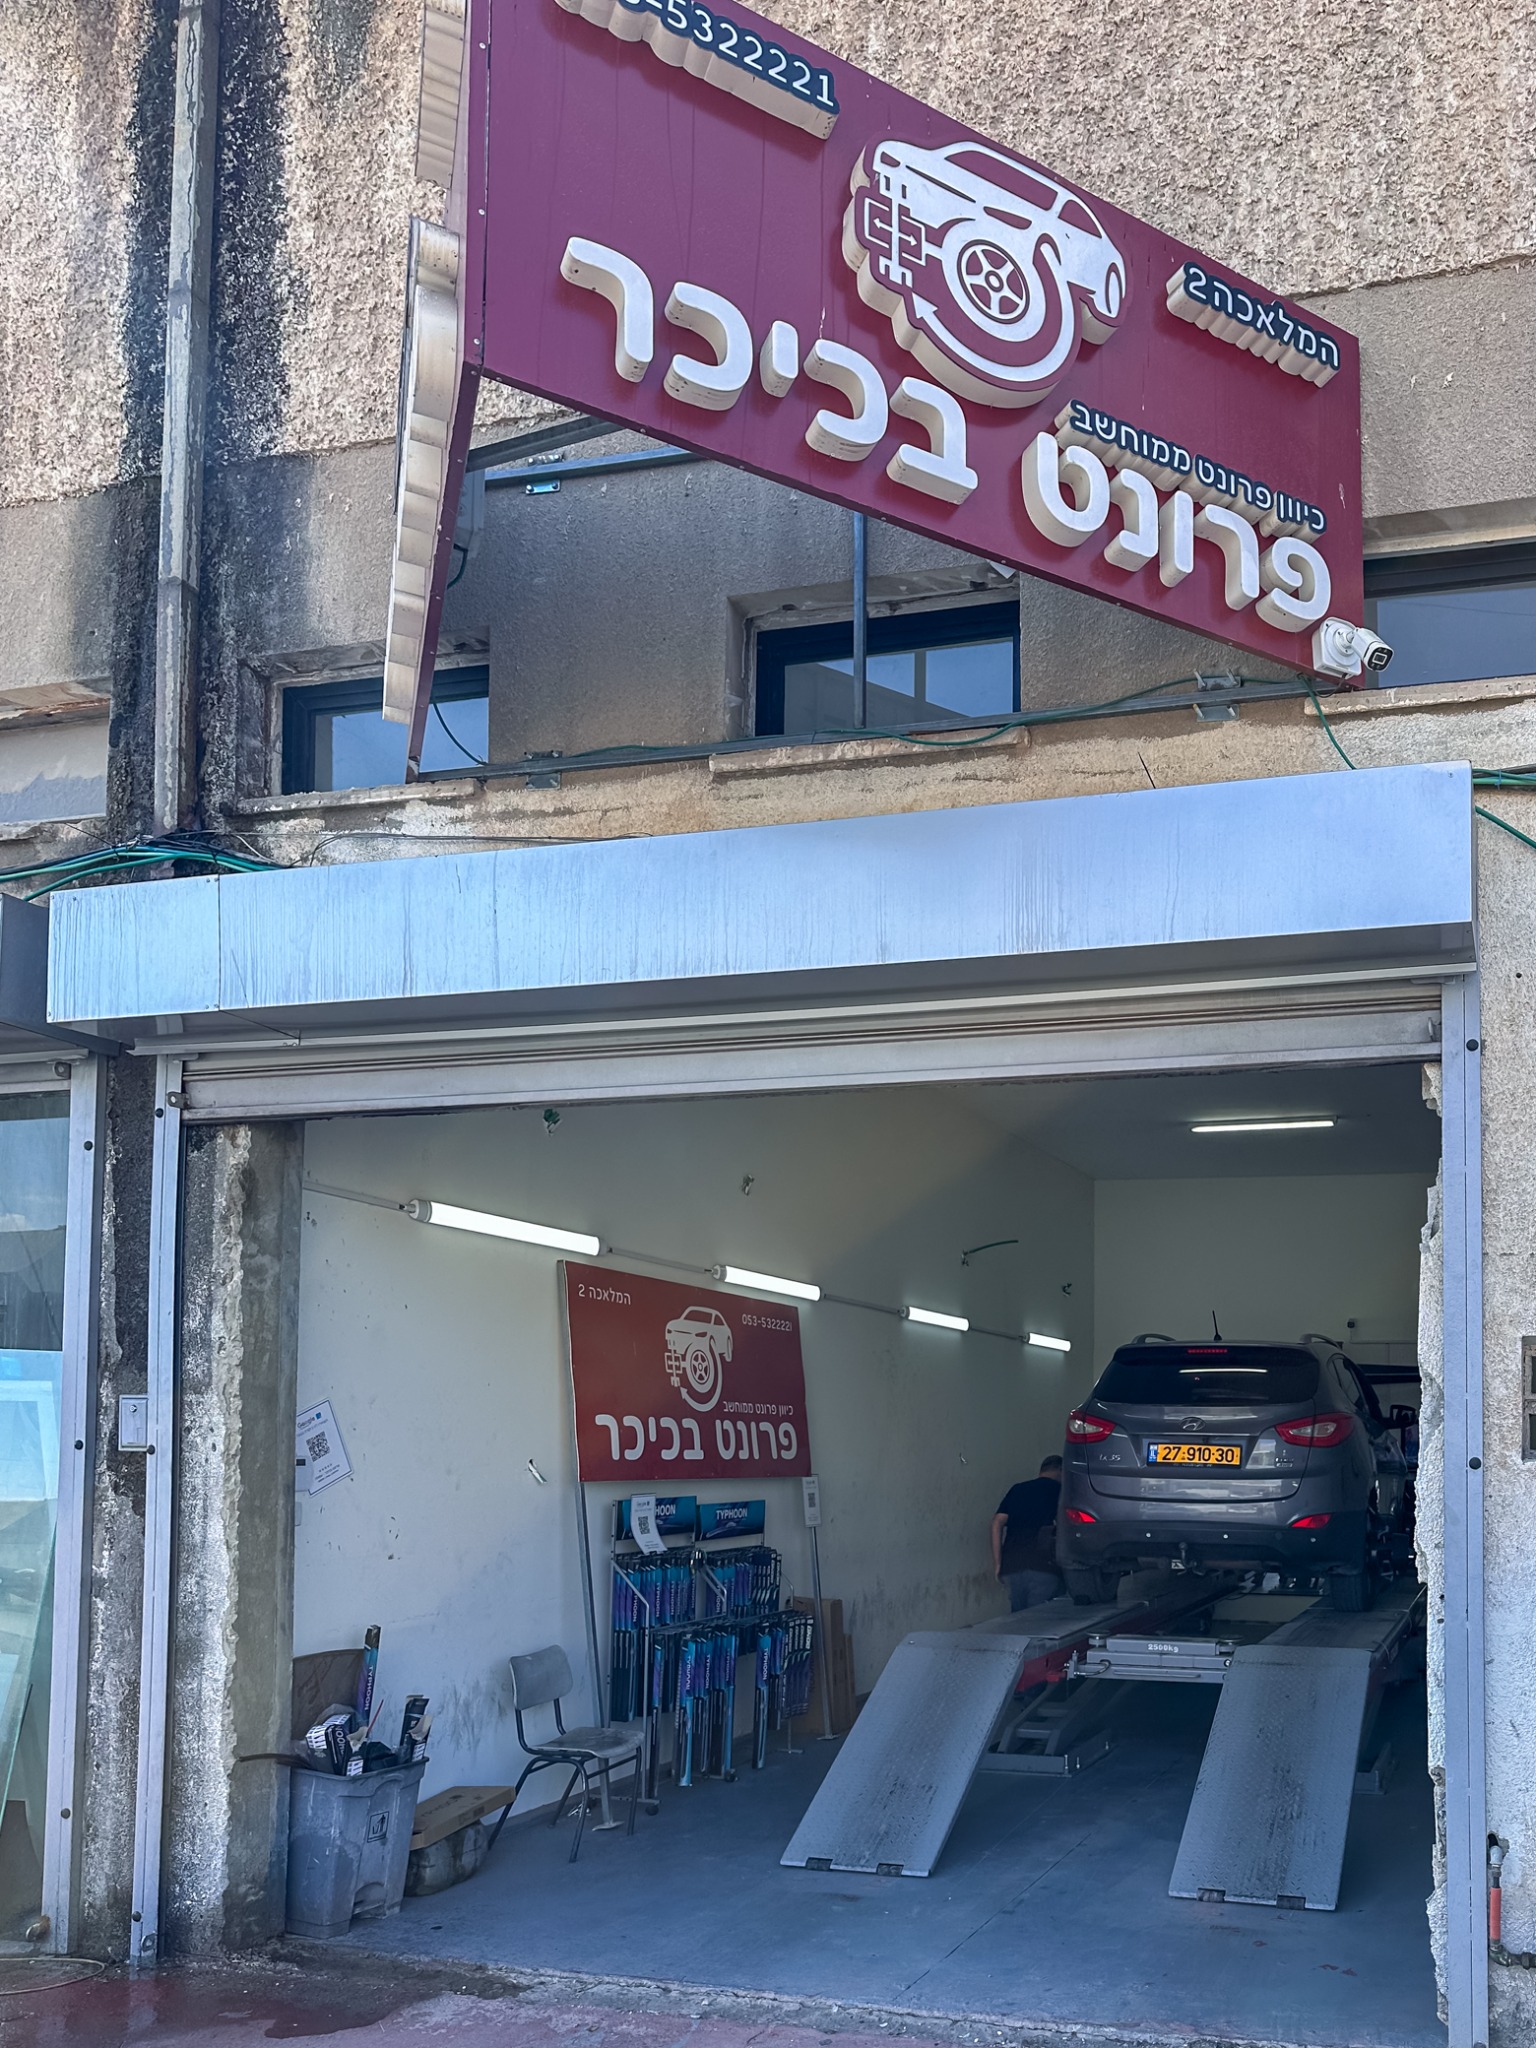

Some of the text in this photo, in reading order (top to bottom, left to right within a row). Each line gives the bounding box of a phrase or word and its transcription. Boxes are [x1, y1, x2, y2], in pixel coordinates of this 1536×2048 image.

[566, 236, 1332, 622] פרונט בכיכר
[1075, 404, 1325, 530] כיוון פרונט ממוחשב
[578, 1283, 631, 1305] המלאכה 2
[741, 1313, 793, 1331] 053-5322221
[722, 1401, 794, 1417] כיוון פרונט ממוחשב
[595, 1413, 798, 1461] פרונט בכיכר
[655, 1504, 676, 1516] HOON
[716, 1507, 748, 1520] TYPHOON
[364, 1665, 374, 1711] TYPHOON
